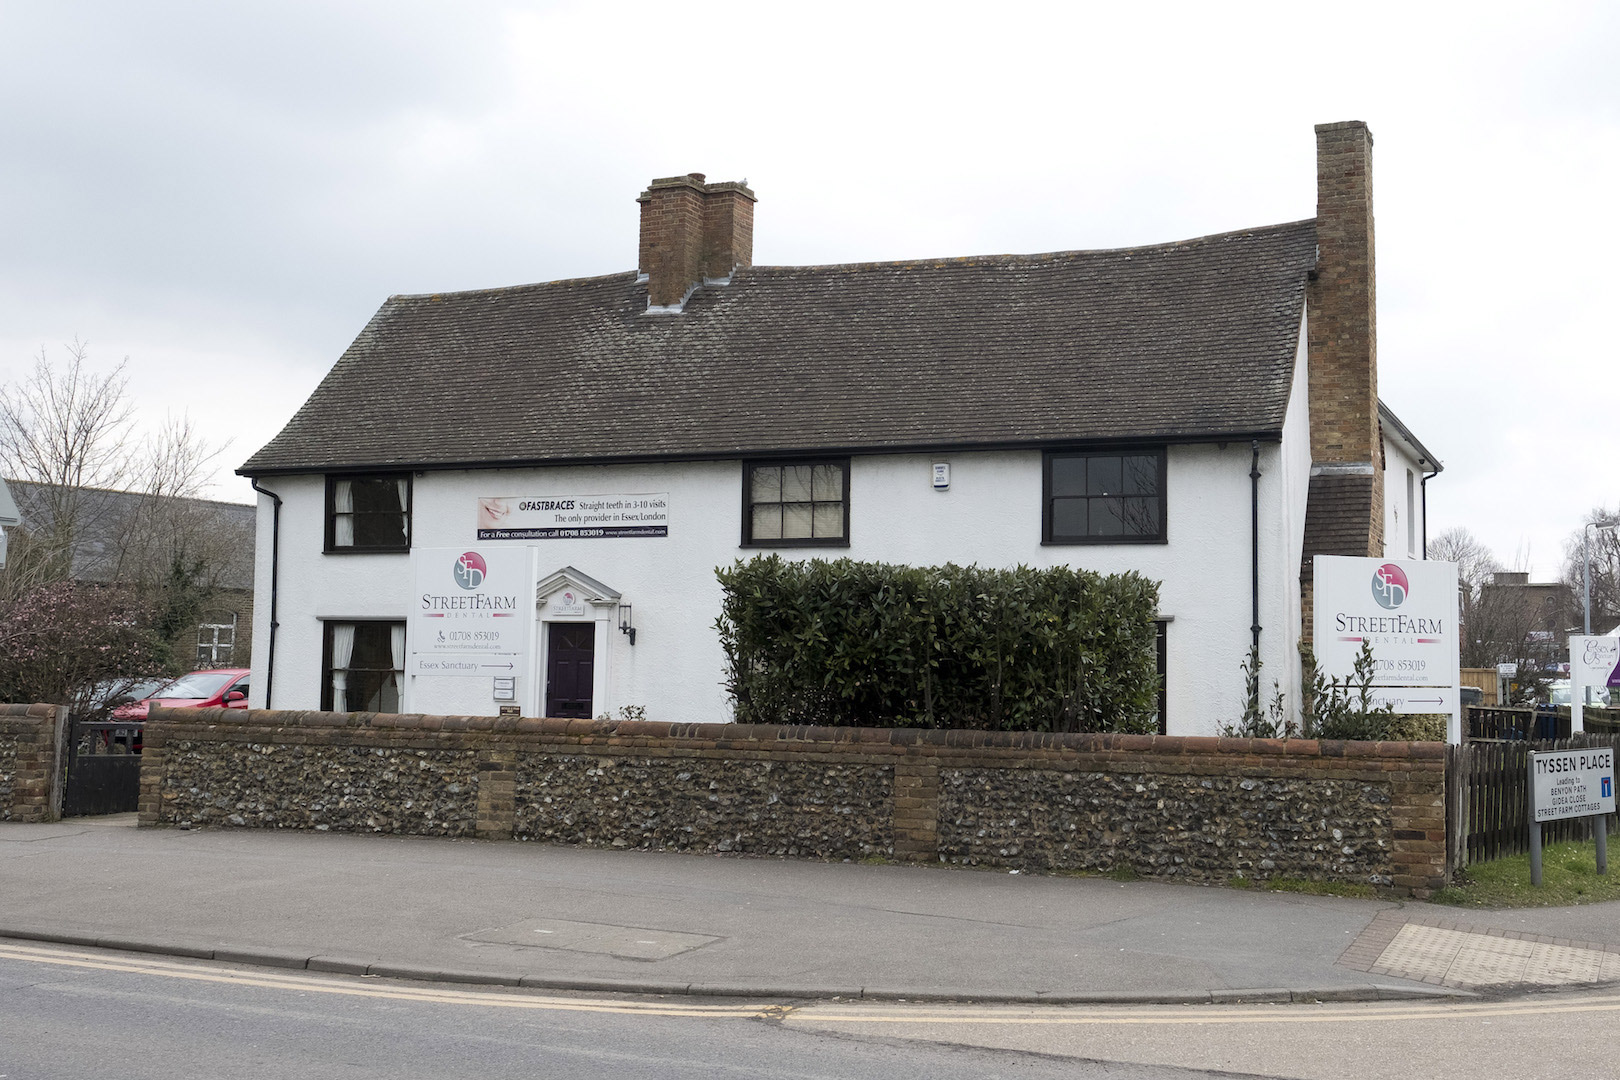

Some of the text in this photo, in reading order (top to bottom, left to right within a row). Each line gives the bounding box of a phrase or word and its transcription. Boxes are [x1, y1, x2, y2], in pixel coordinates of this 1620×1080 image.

[526, 499, 666, 512] FASTBRACES Straight teeth in 3-10 visits
[554, 514, 567, 522] The
[568, 513, 582, 525] only
[584, 512, 612, 524] provider
[613, 512, 620, 520] in
[560, 529, 578, 537] 01708
[580, 528, 604, 536] 853019
[450, 631, 500, 641] 01708 853019
[420, 660, 478, 672] Essex Sanctuary
[1398, 659, 1426, 672] 853019
[1536, 754, 1611, 774] TYSSEN PLACE
[1556, 777, 1574, 786] Leading
[1551, 786, 1573, 796] BENYON
[1552, 795, 1586, 805] GIDEA CLOSE
[1538, 802, 1600, 817] STREET FARM COTTAGES
